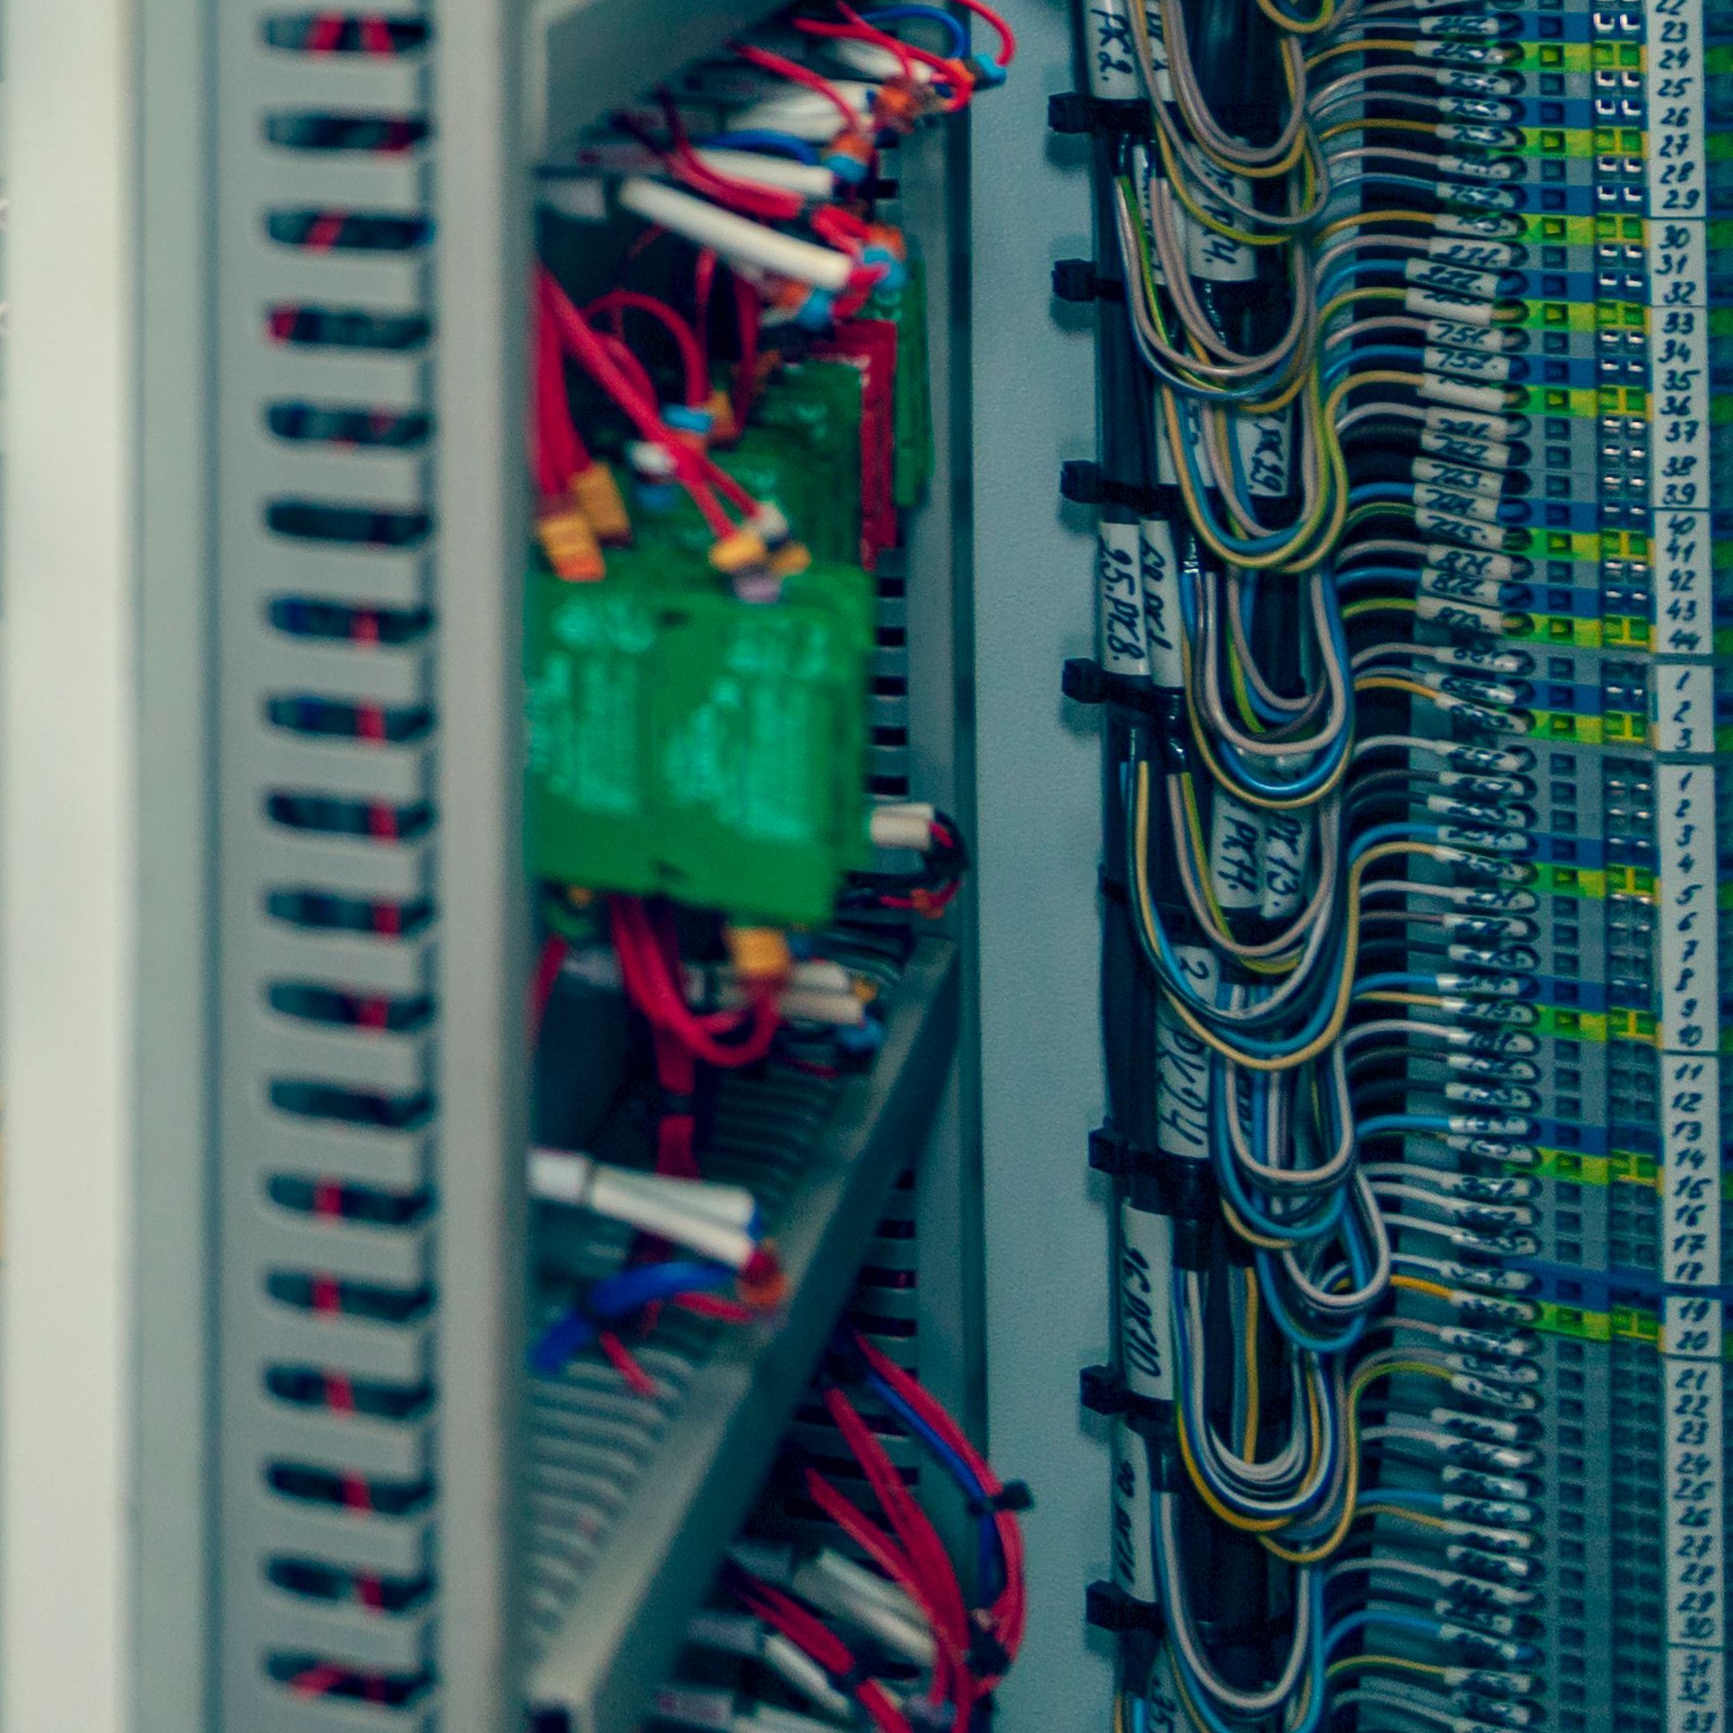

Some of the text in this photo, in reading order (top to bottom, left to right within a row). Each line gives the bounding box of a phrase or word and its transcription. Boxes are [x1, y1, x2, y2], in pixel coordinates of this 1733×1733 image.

[1661, 21, 1688, 43] 23
[1659, 47, 1690, 70] 24
[1658, 77, 1693, 98] 25
[1661, 107, 1690, 127] 26
[1659, 134, 1689, 158] 27
[1660, 161, 1695, 184] 28
[1663, 189, 1700, 210] 29
[1660, 225, 1690, 249] 30
[1656, 254, 1687, 275] 31
[1663, 282, 1696, 304] 32
[1663, 312, 1694, 335] 33
[1658, 339, 1691, 363] 34
[1663, 370, 1701, 391] 35
[1660, 396, 1691, 416] 36
[1666, 420, 1699, 442] 37
[1662, 456, 1697, 477] 38
[1663, 483, 1697, 505] 39
[1668, 514, 1696, 534] 40
[1666, 536, 1695, 562] 41
[1669, 569, 1696, 591] 42
[1667, 599, 1697, 621] 43
[1676, 671, 1691, 690] 1
[1673, 701, 1691, 723] 2
[1676, 728, 1693, 751] 3
[1679, 772, 1693, 791] 1
[1675, 799, 1691, 818] 2
[1676, 824, 1696, 847] 3
[1676, 884, 1703, 906] 5
[1678, 912, 1697, 932] 6
[1683, 940, 1699, 962] 7
[1681, 998, 1697, 1018] 9
[1675, 1064, 1703, 1080] 11
[1676, 1421, 1709, 1445] 23
